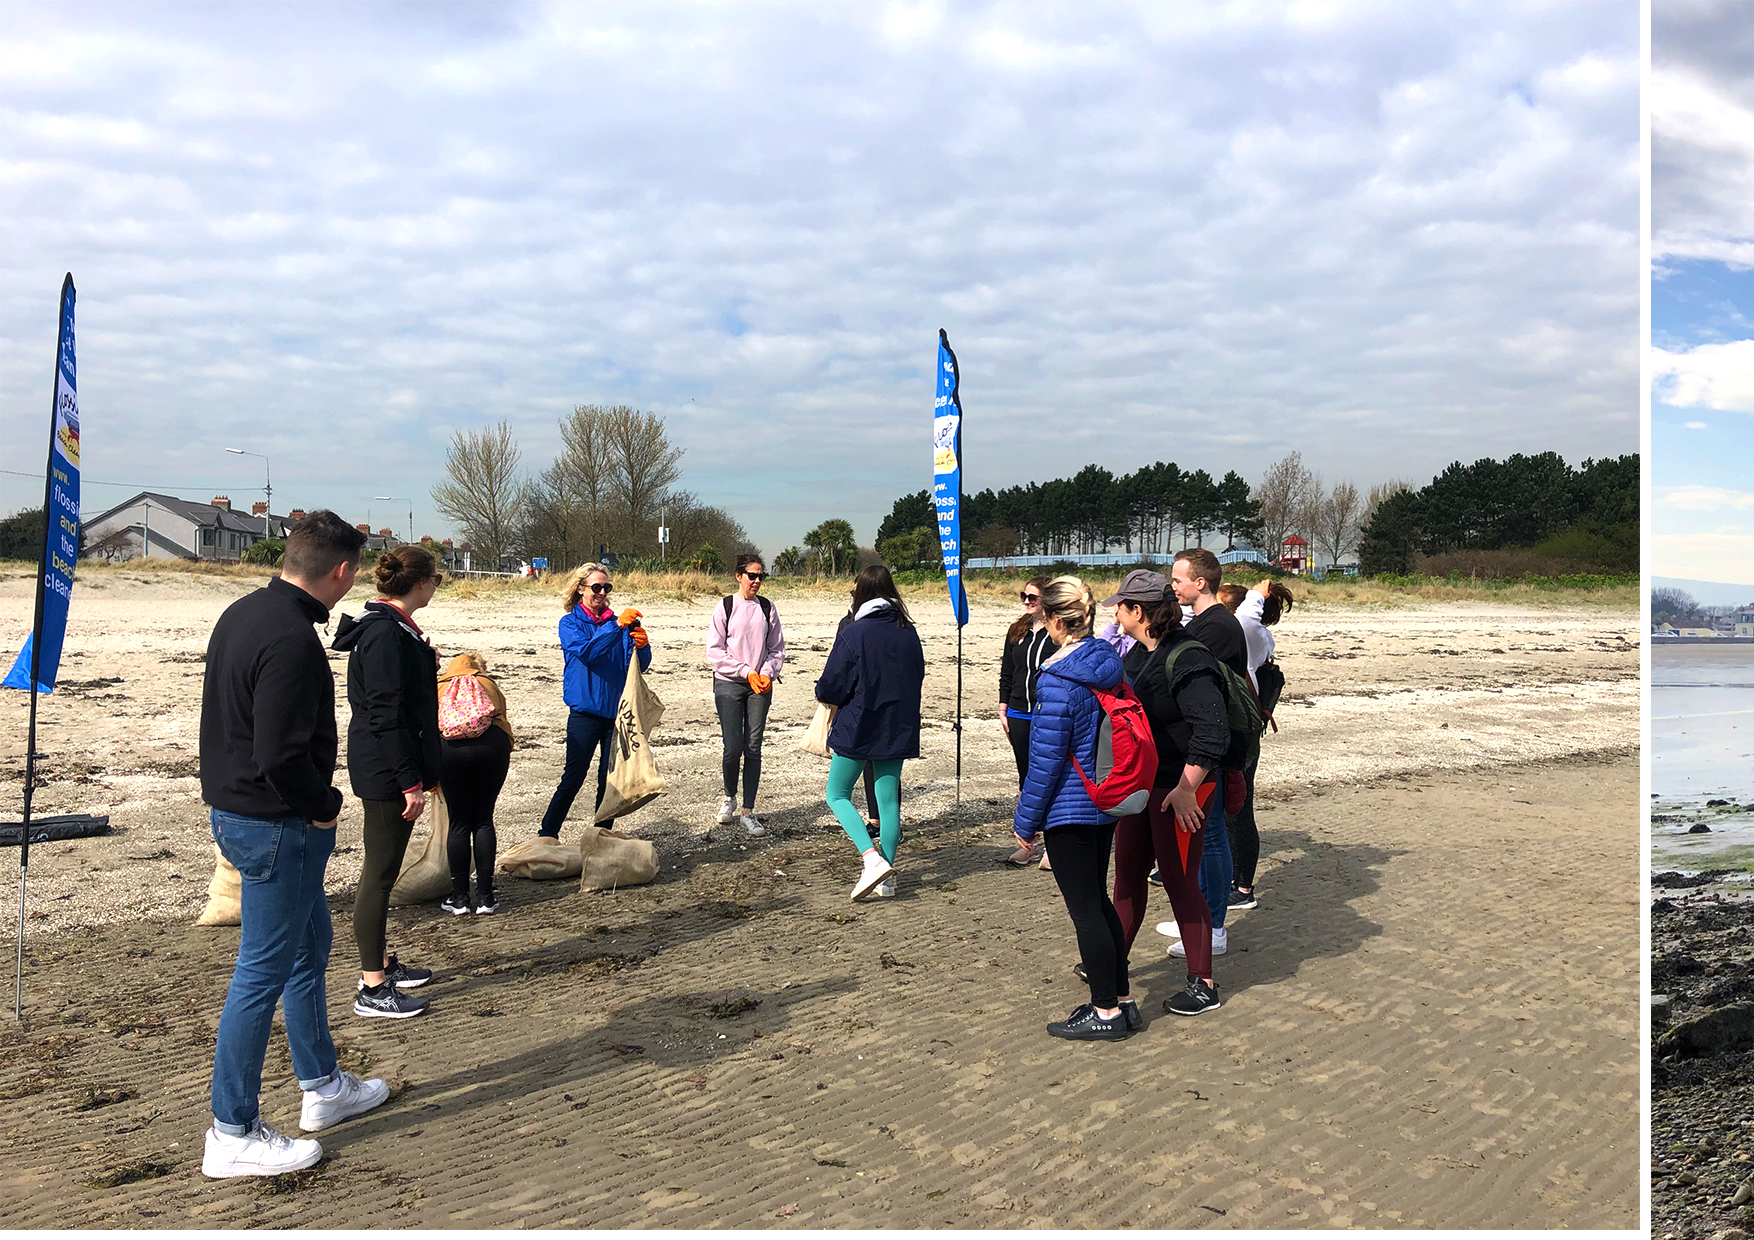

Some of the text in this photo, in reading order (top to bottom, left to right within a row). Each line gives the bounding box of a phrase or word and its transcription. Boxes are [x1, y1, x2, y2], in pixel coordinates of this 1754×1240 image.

[54, 484, 79, 517] flossi
[60, 514, 77, 538] and
[61, 534, 74, 558] the
